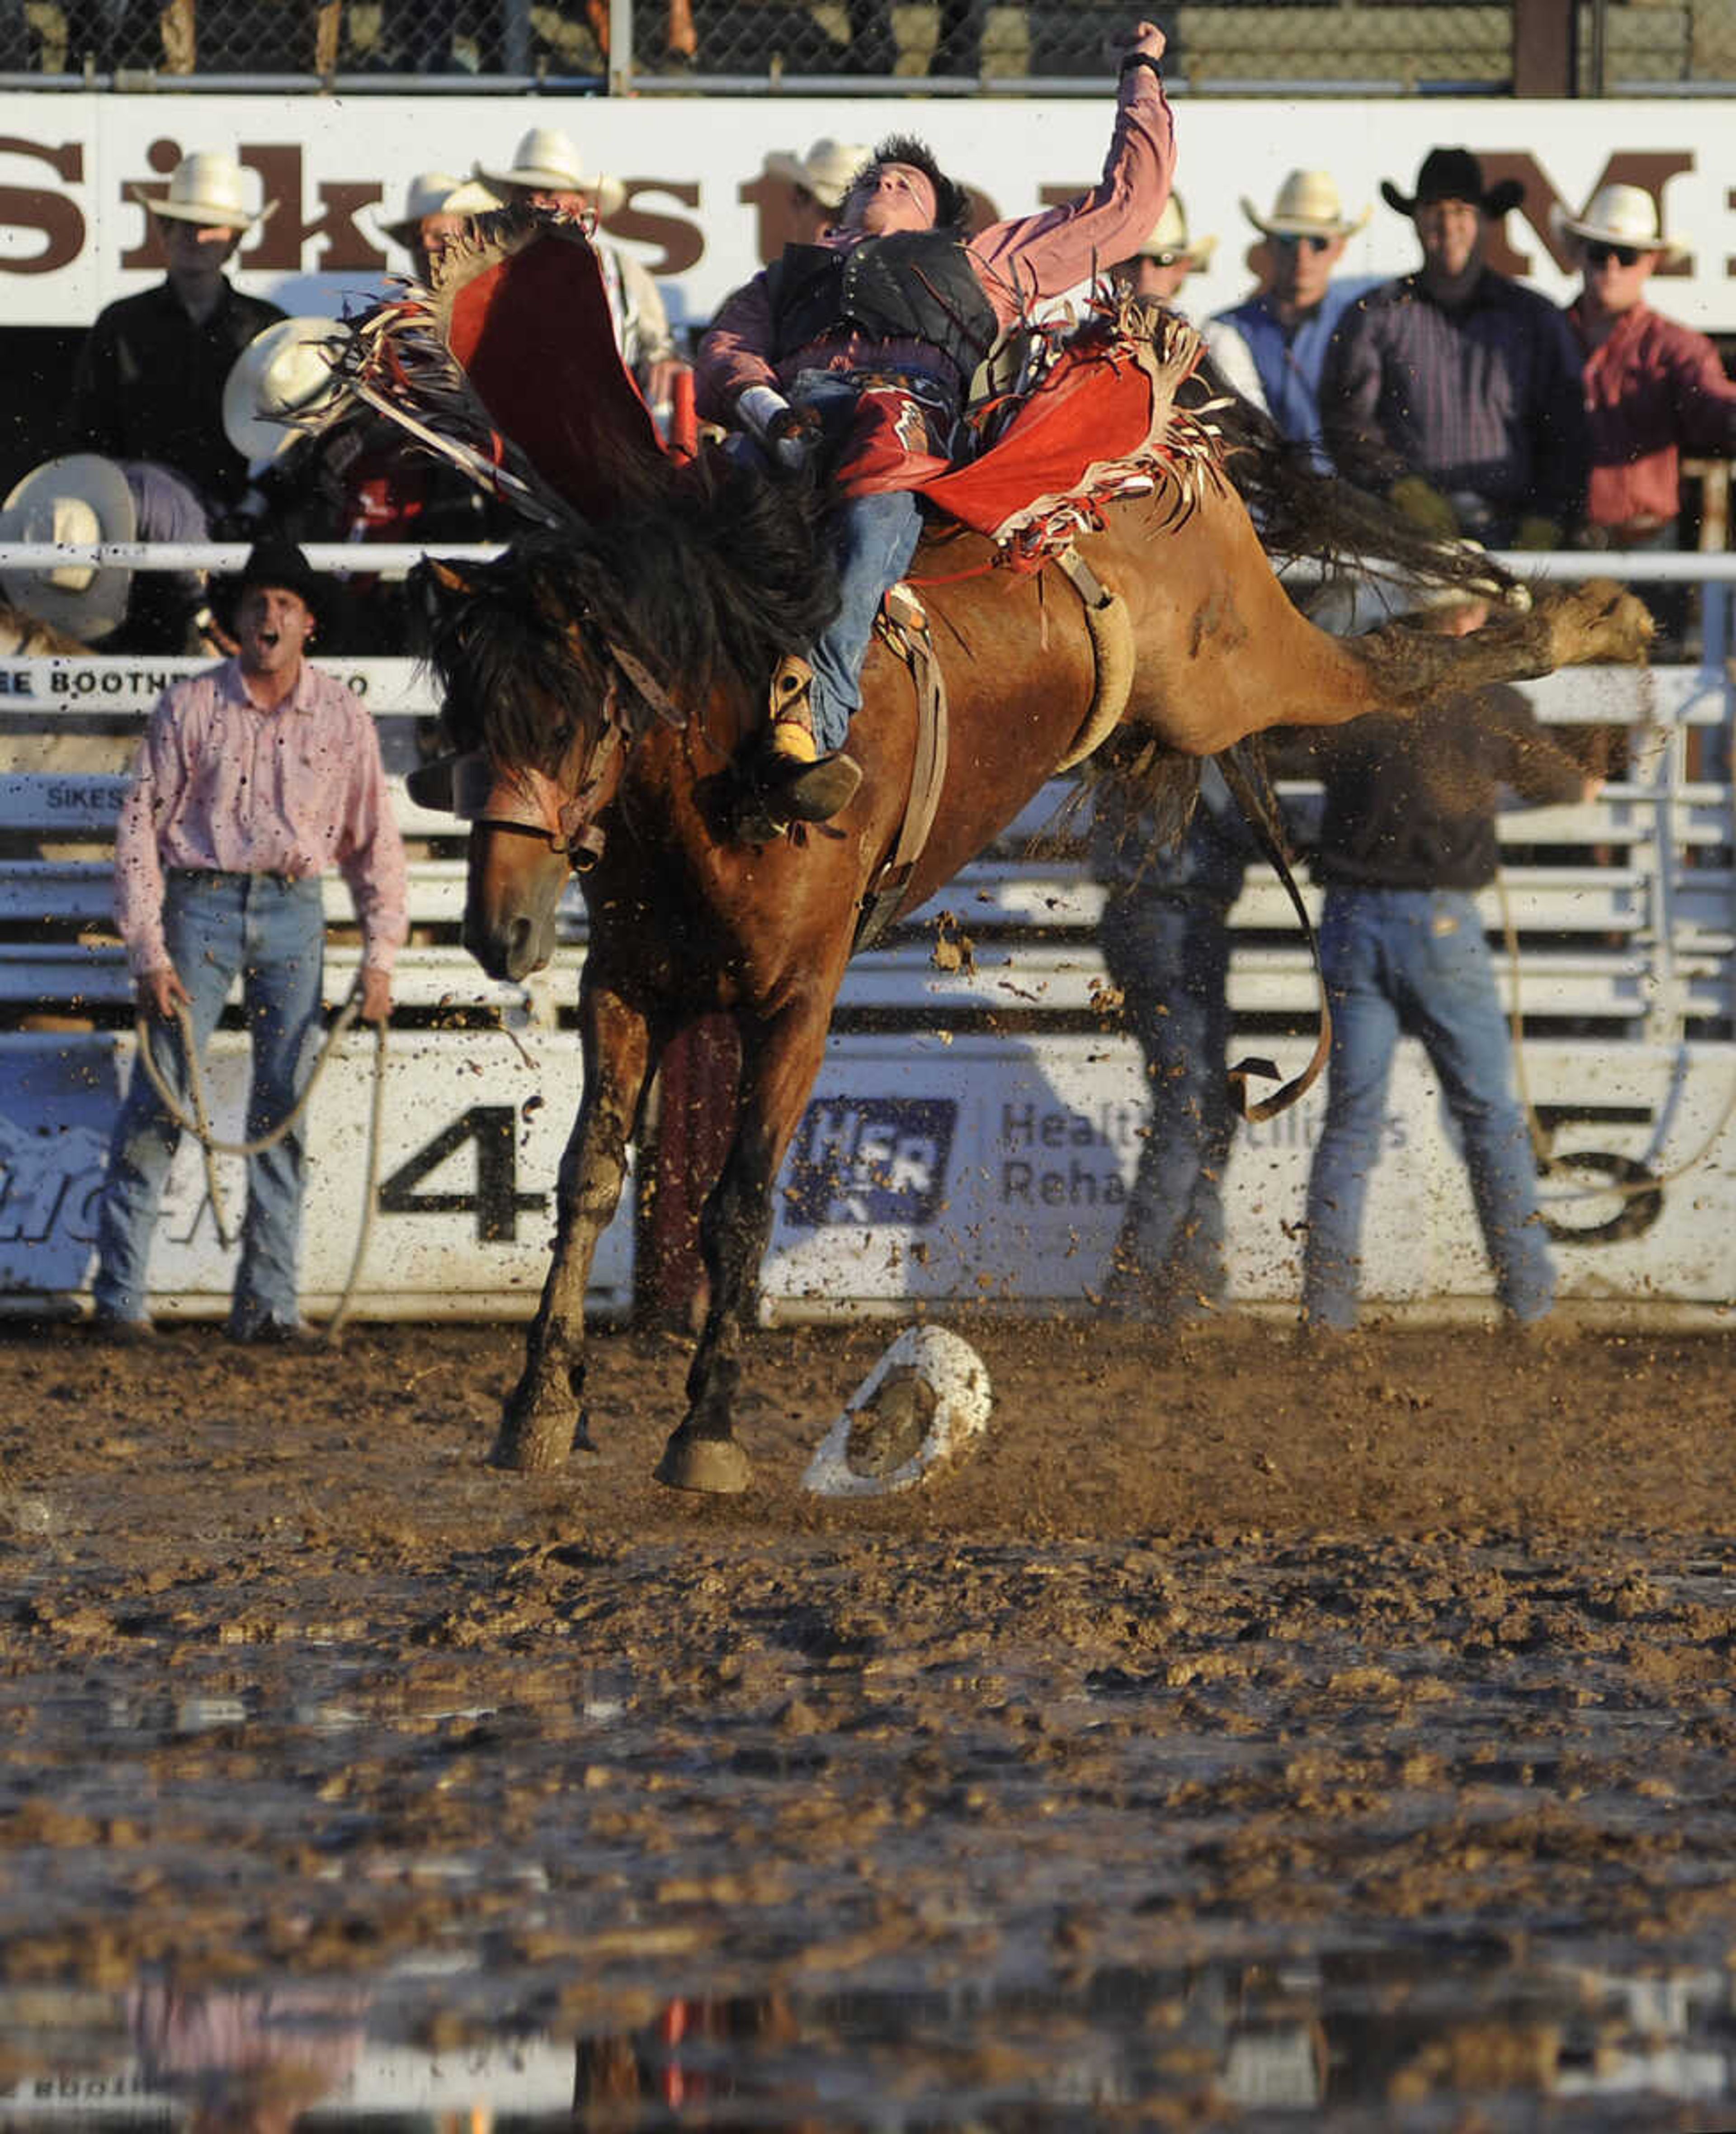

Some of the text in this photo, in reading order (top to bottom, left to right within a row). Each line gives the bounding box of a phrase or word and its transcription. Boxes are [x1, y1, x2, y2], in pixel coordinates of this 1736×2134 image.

[1002, 1103, 1137, 1147] Healt
[379, 1106, 548, 1242] 4
[1002, 1158, 1128, 1206] Reha
[1533, 1104, 1665, 1245] 5
